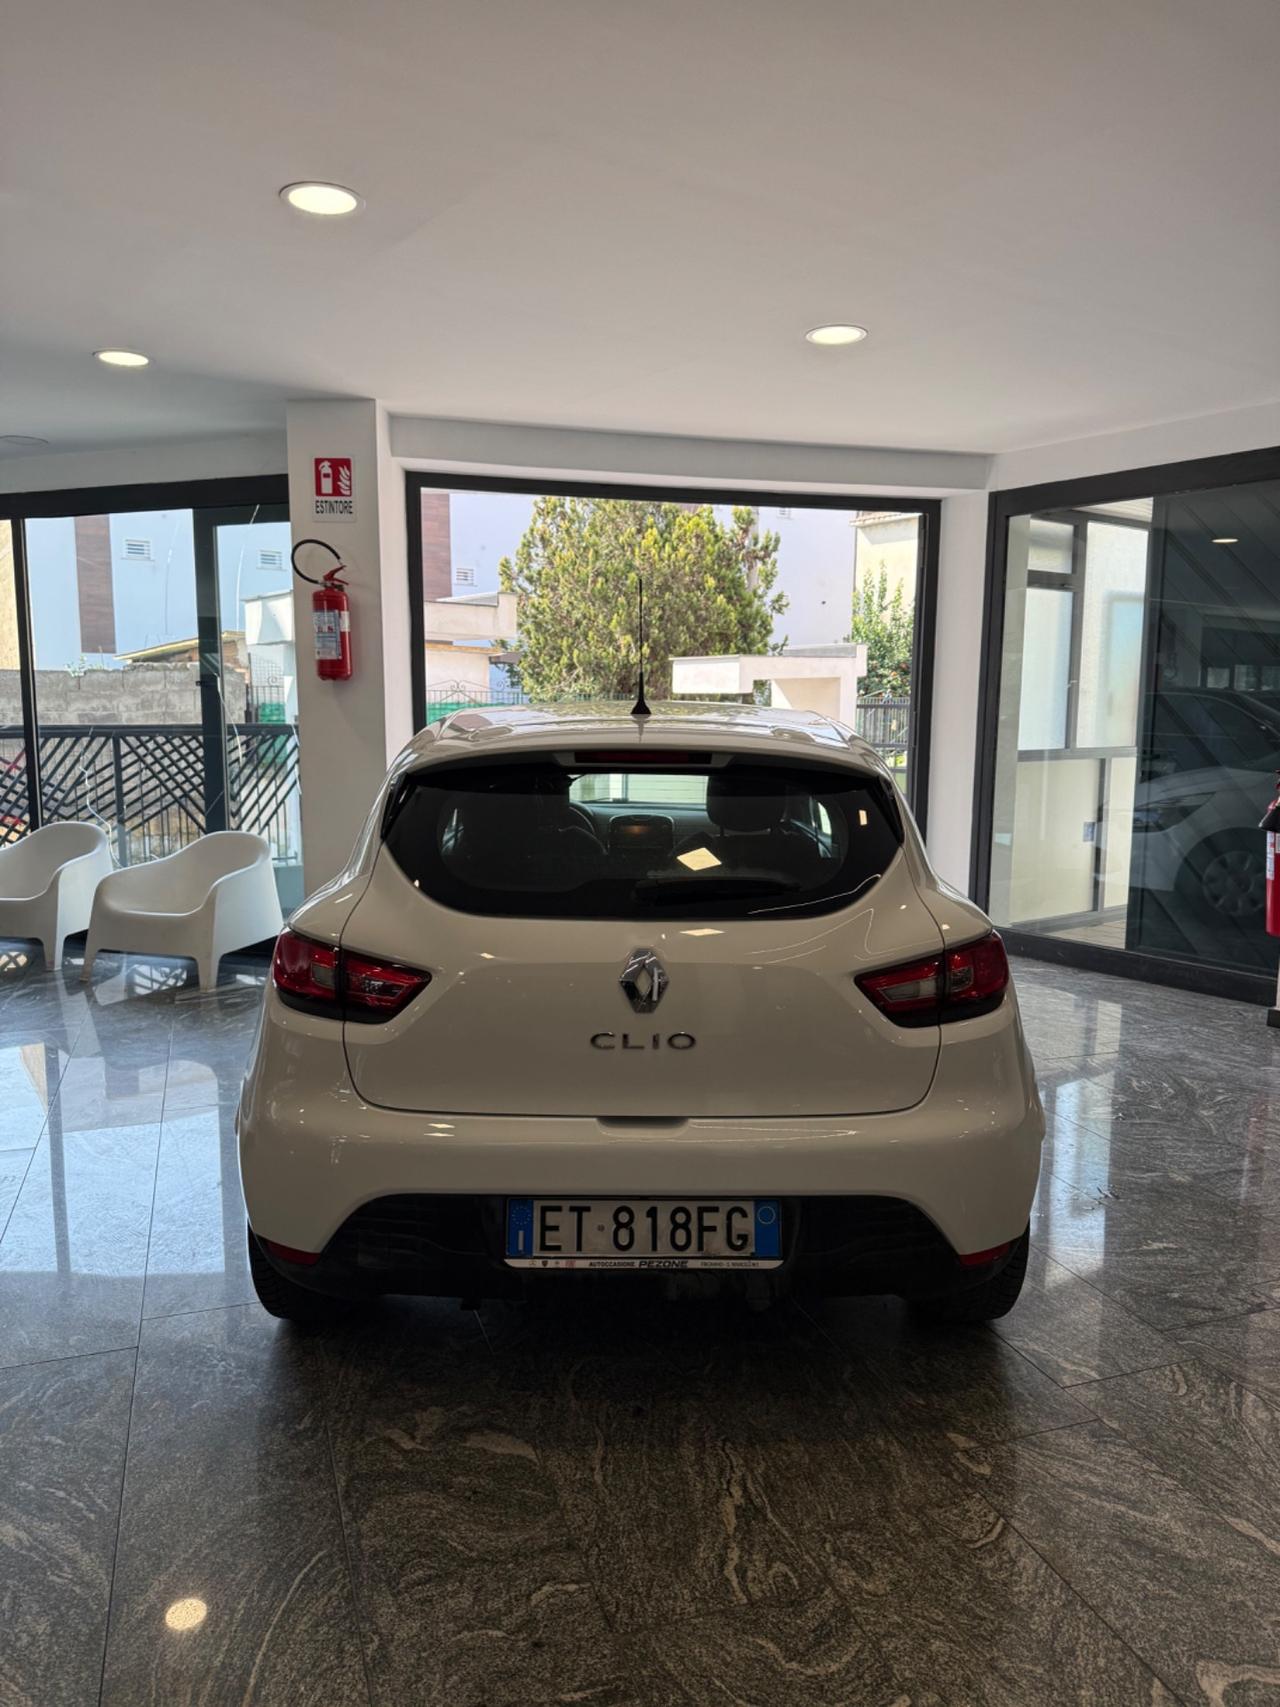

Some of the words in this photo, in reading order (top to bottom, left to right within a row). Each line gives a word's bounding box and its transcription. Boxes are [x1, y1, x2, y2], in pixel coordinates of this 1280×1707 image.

[315, 500, 353, 514] ESTINTORE
[590, 1031, 696, 1050] CLIO
[540, 1205, 591, 1251] ET
[612, 1205, 749, 1252] 818FG
[638, 1260, 689, 1269] PEZONE
